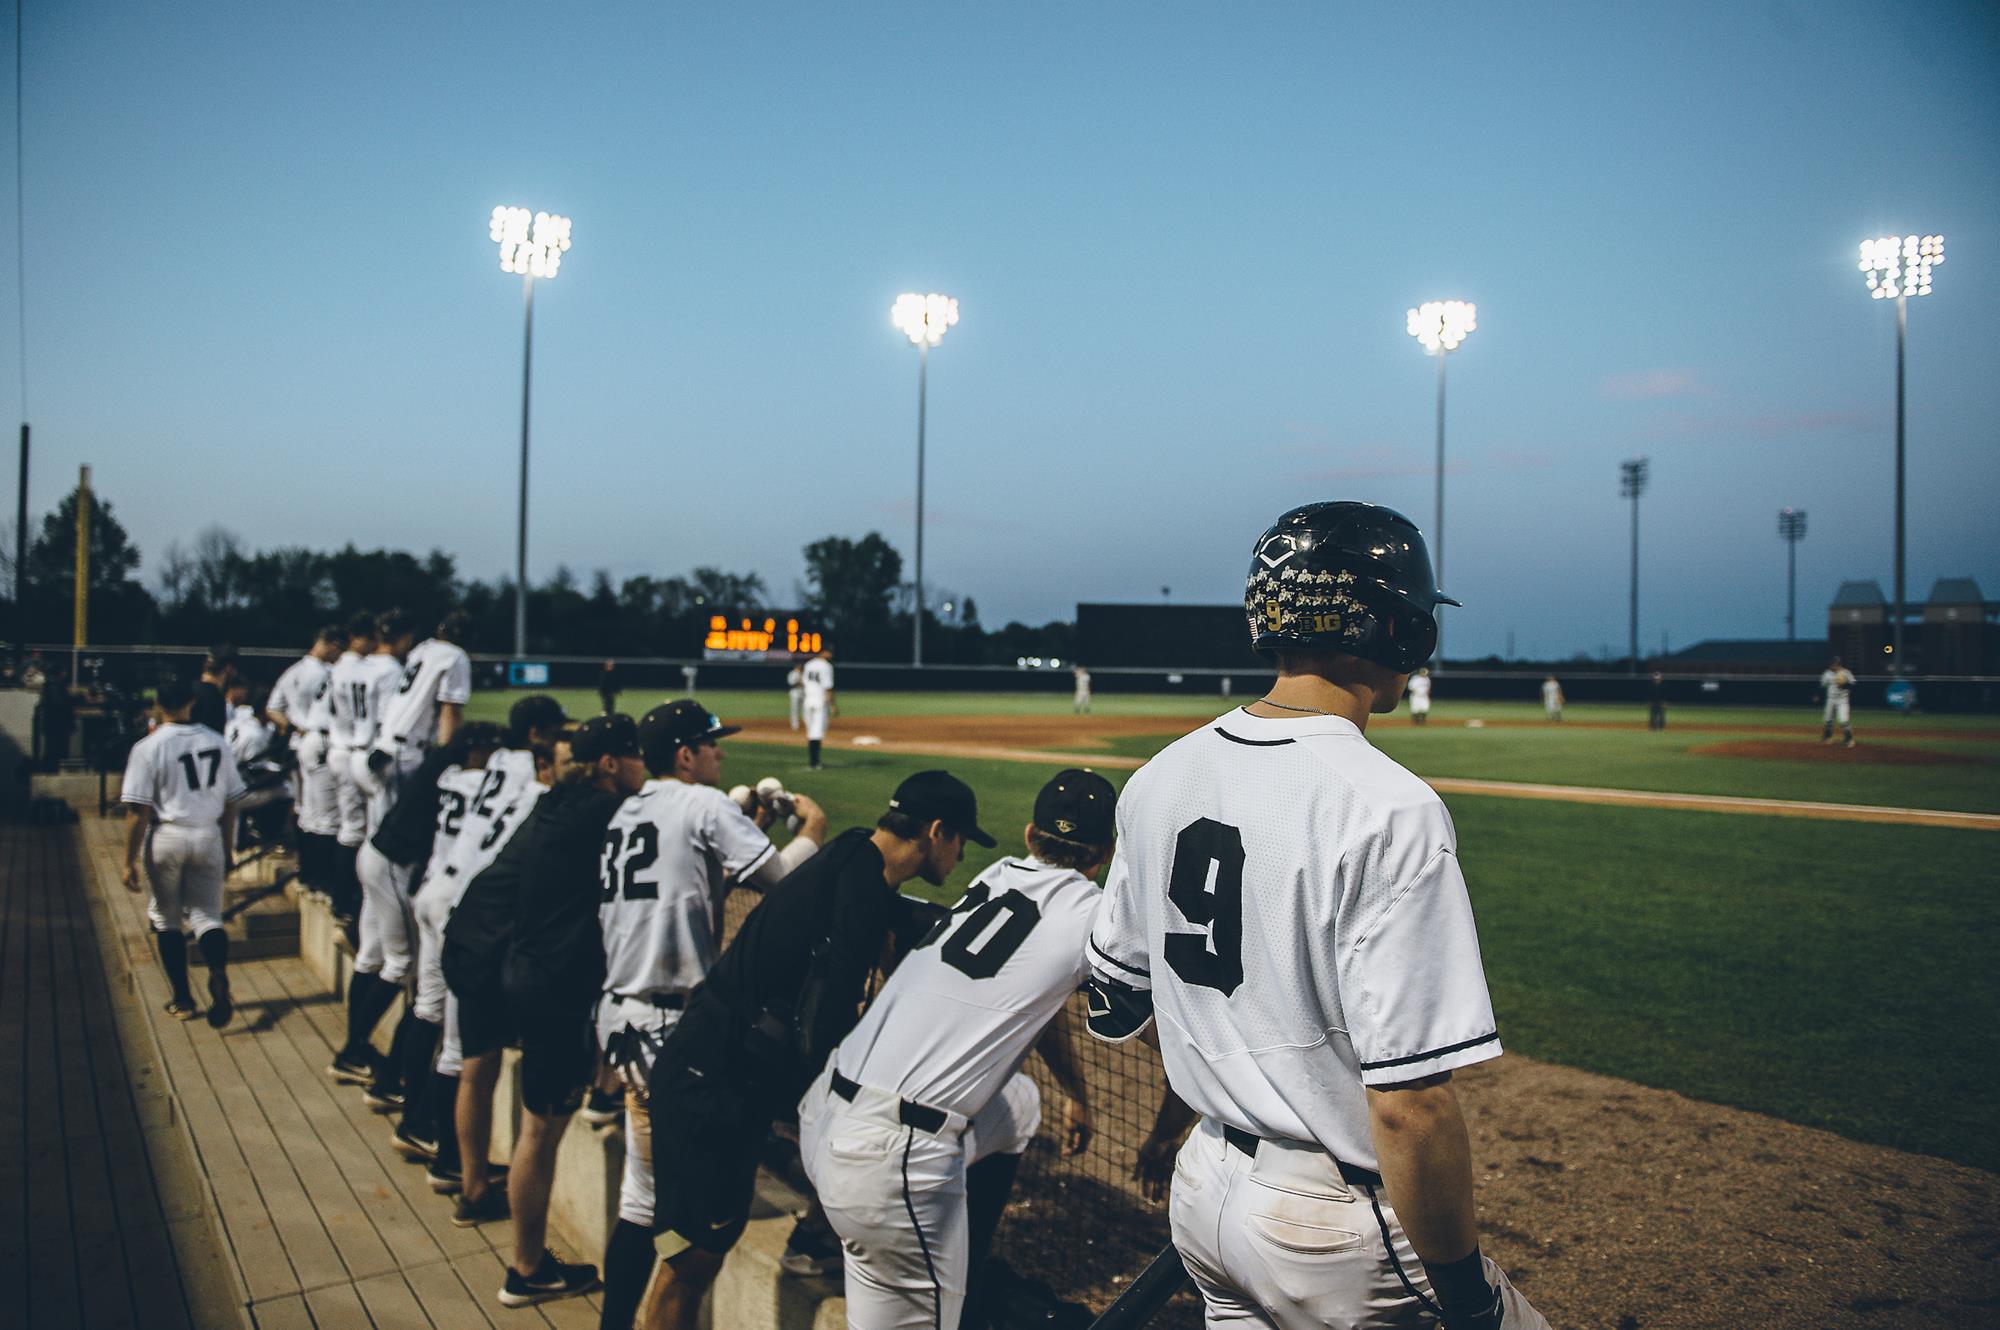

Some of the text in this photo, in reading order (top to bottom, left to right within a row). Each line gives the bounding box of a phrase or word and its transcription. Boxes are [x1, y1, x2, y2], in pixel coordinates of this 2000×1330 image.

[1265, 599, 1282, 632] 9
[178, 748, 222, 791] 17
[600, 821, 659, 903] 32
[1164, 816, 1247, 997] 9
